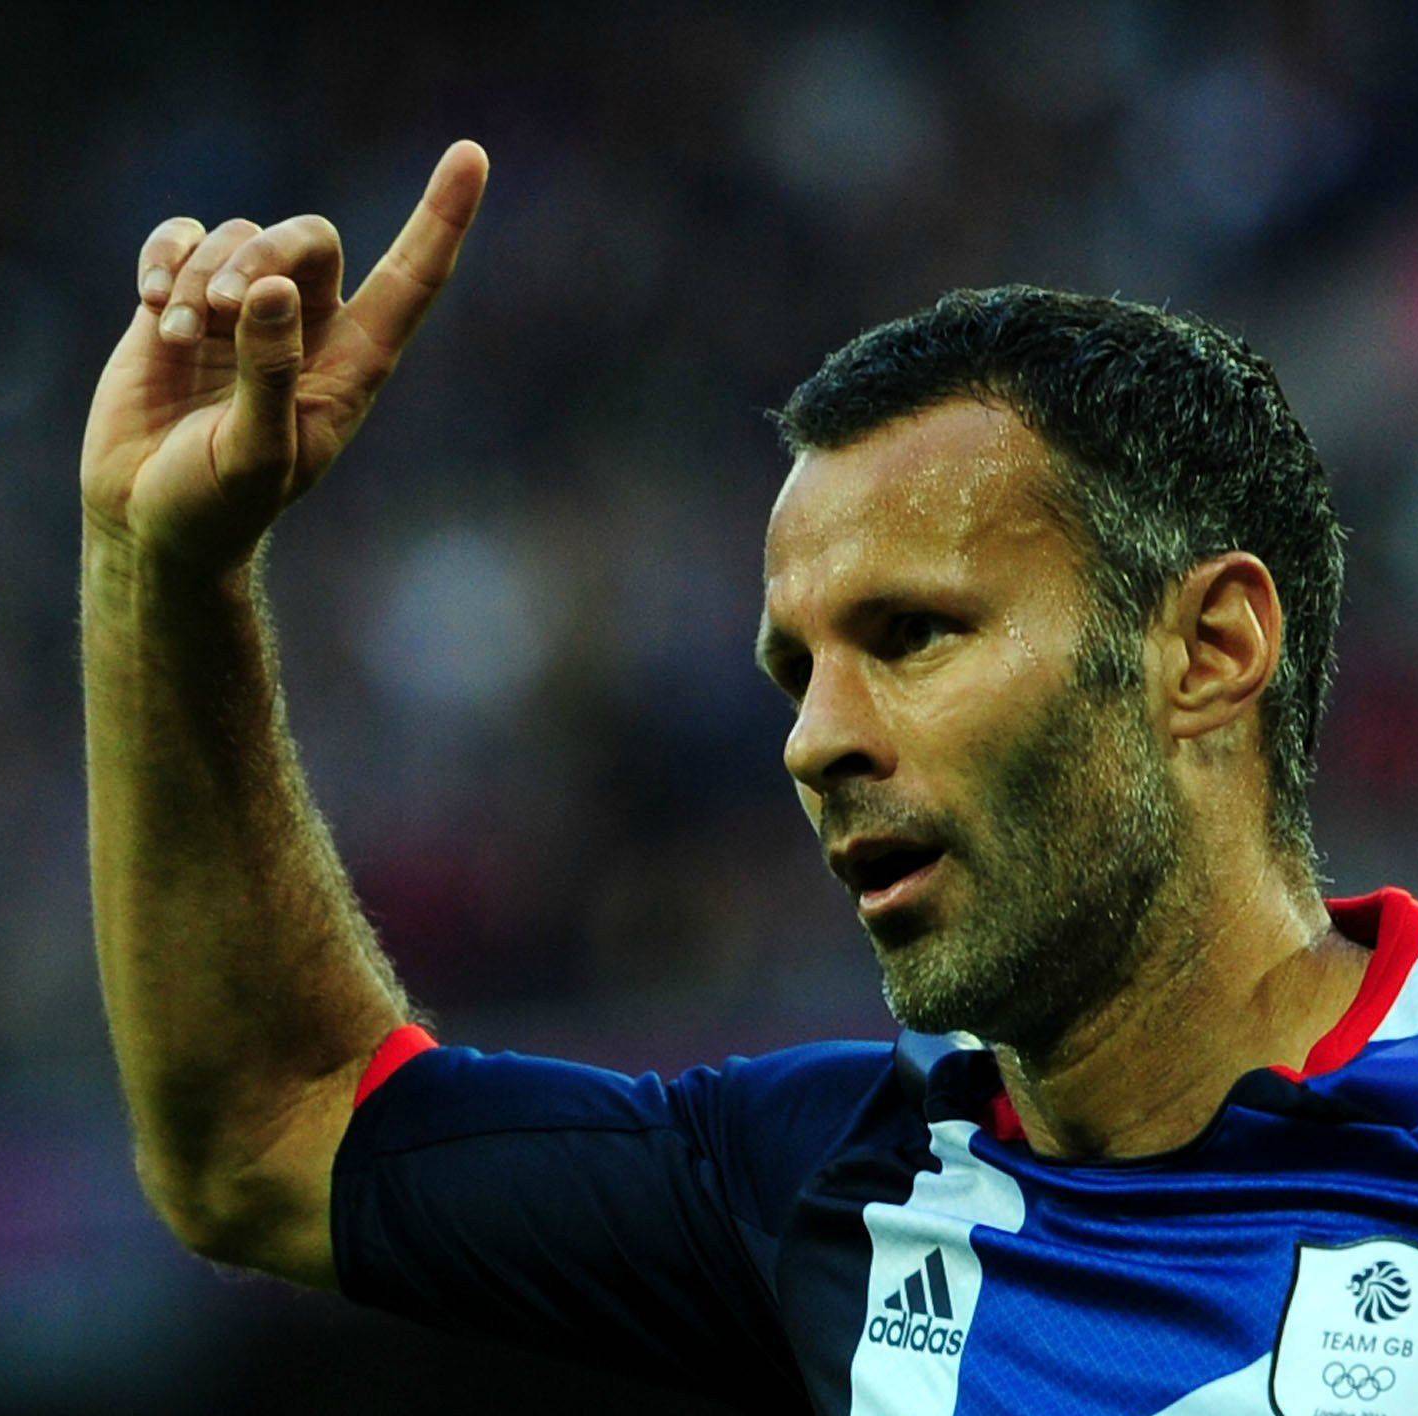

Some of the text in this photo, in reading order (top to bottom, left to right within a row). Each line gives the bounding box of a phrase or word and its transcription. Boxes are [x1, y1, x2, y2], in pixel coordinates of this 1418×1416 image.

[868, 1311, 964, 1356] adidas
[1322, 1331, 1414, 1357] TEAM GB
